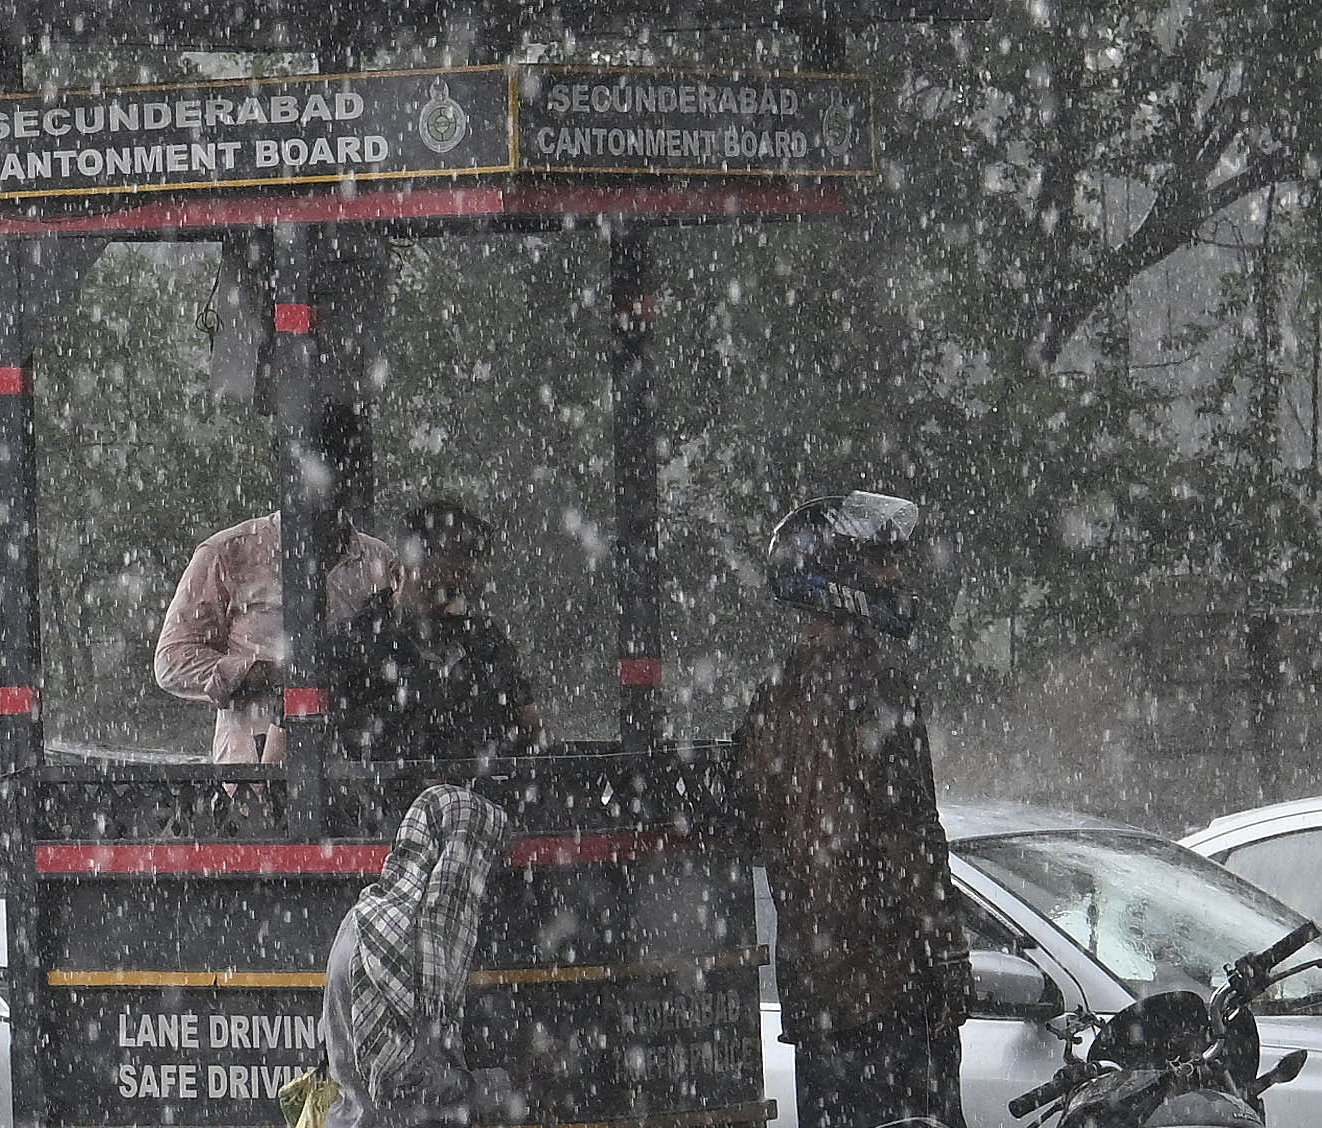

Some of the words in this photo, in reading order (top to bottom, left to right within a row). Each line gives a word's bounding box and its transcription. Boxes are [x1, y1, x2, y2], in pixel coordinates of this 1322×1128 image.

[548, 84, 798, 116] SECUNDERABAD
[255, 136, 389, 169] BOARD
[537, 127, 715, 156] CANTONMENT
[724, 129, 807, 158] BOARD
[119, 1014, 199, 1048] LANE
[119, 1064, 197, 1099] SAFE
